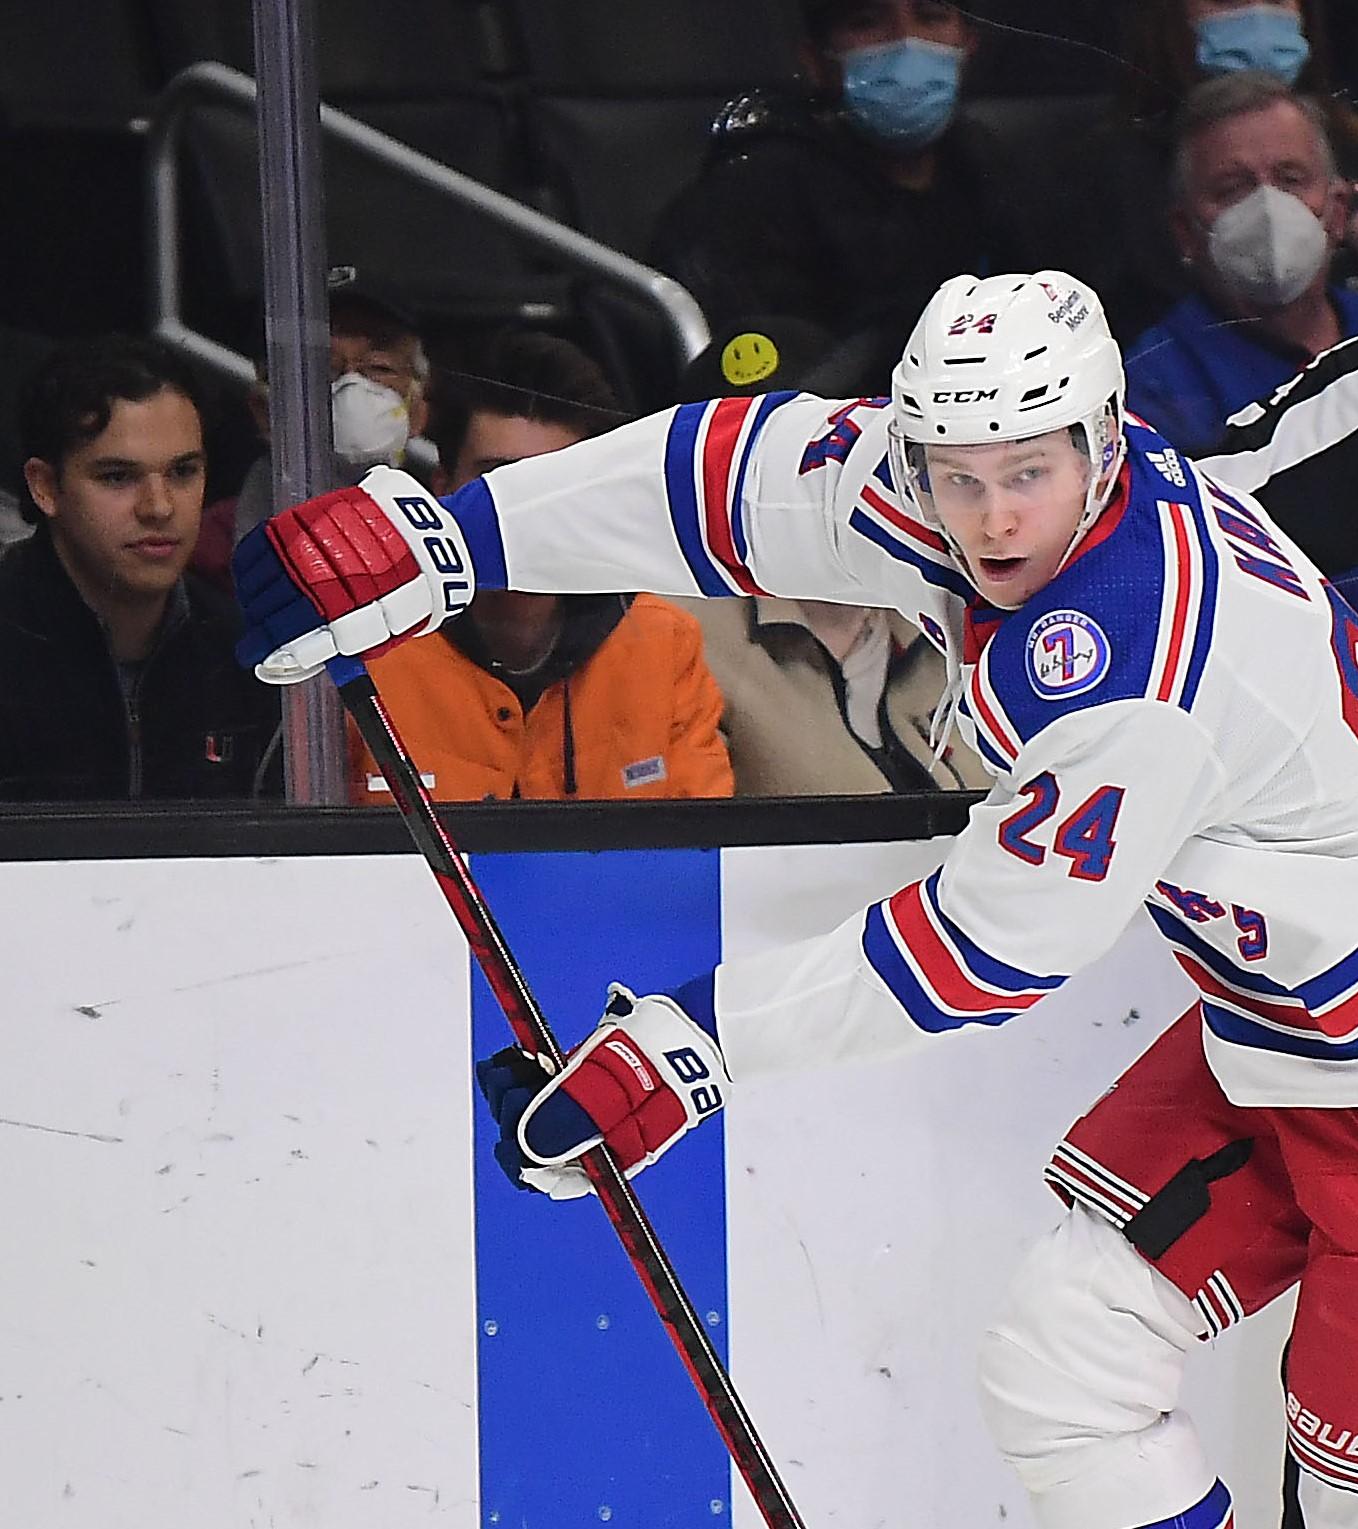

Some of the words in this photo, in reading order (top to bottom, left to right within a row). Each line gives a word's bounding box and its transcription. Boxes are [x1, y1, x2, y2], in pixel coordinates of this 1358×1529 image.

[1047, 290, 1082, 324] Benjamin
[948, 313, 998, 336] 24
[933, 388, 999, 404] CCM
[1042, 626, 1075, 681] 7
[998, 769, 1127, 883] 24
